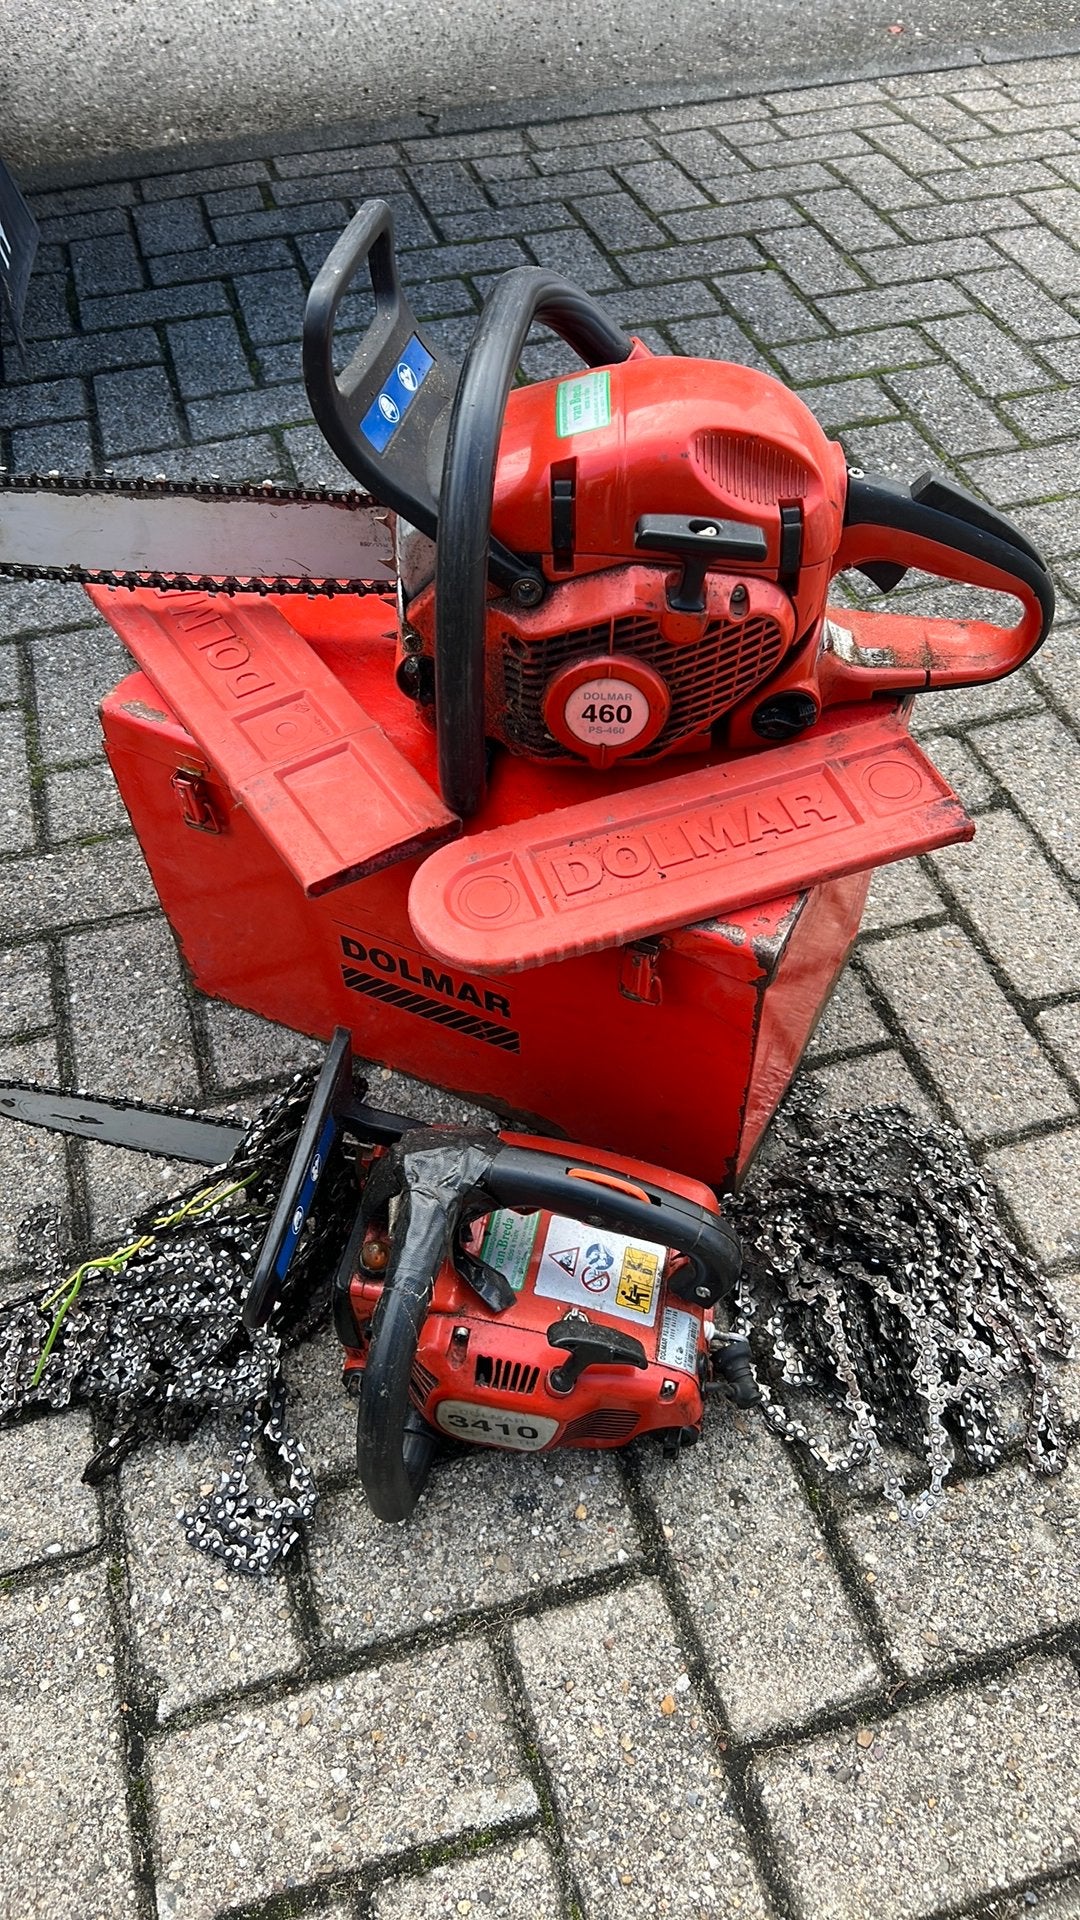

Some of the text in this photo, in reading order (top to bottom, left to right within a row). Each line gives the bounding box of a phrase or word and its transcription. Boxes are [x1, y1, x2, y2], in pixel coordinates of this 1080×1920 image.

[583, 692, 633, 701] DOLMAR
[581, 704, 632, 724] 460
[588, 726, 625, 735] PS-460
[551, 794, 838, 897] DOLMAR
[340, 935, 512, 1020] DOLMAR
[494, 1217, 514, 1268] van Breda
[660, 1337, 668, 1361] DOLMAR
[447, 1414, 539, 1439] 3410
